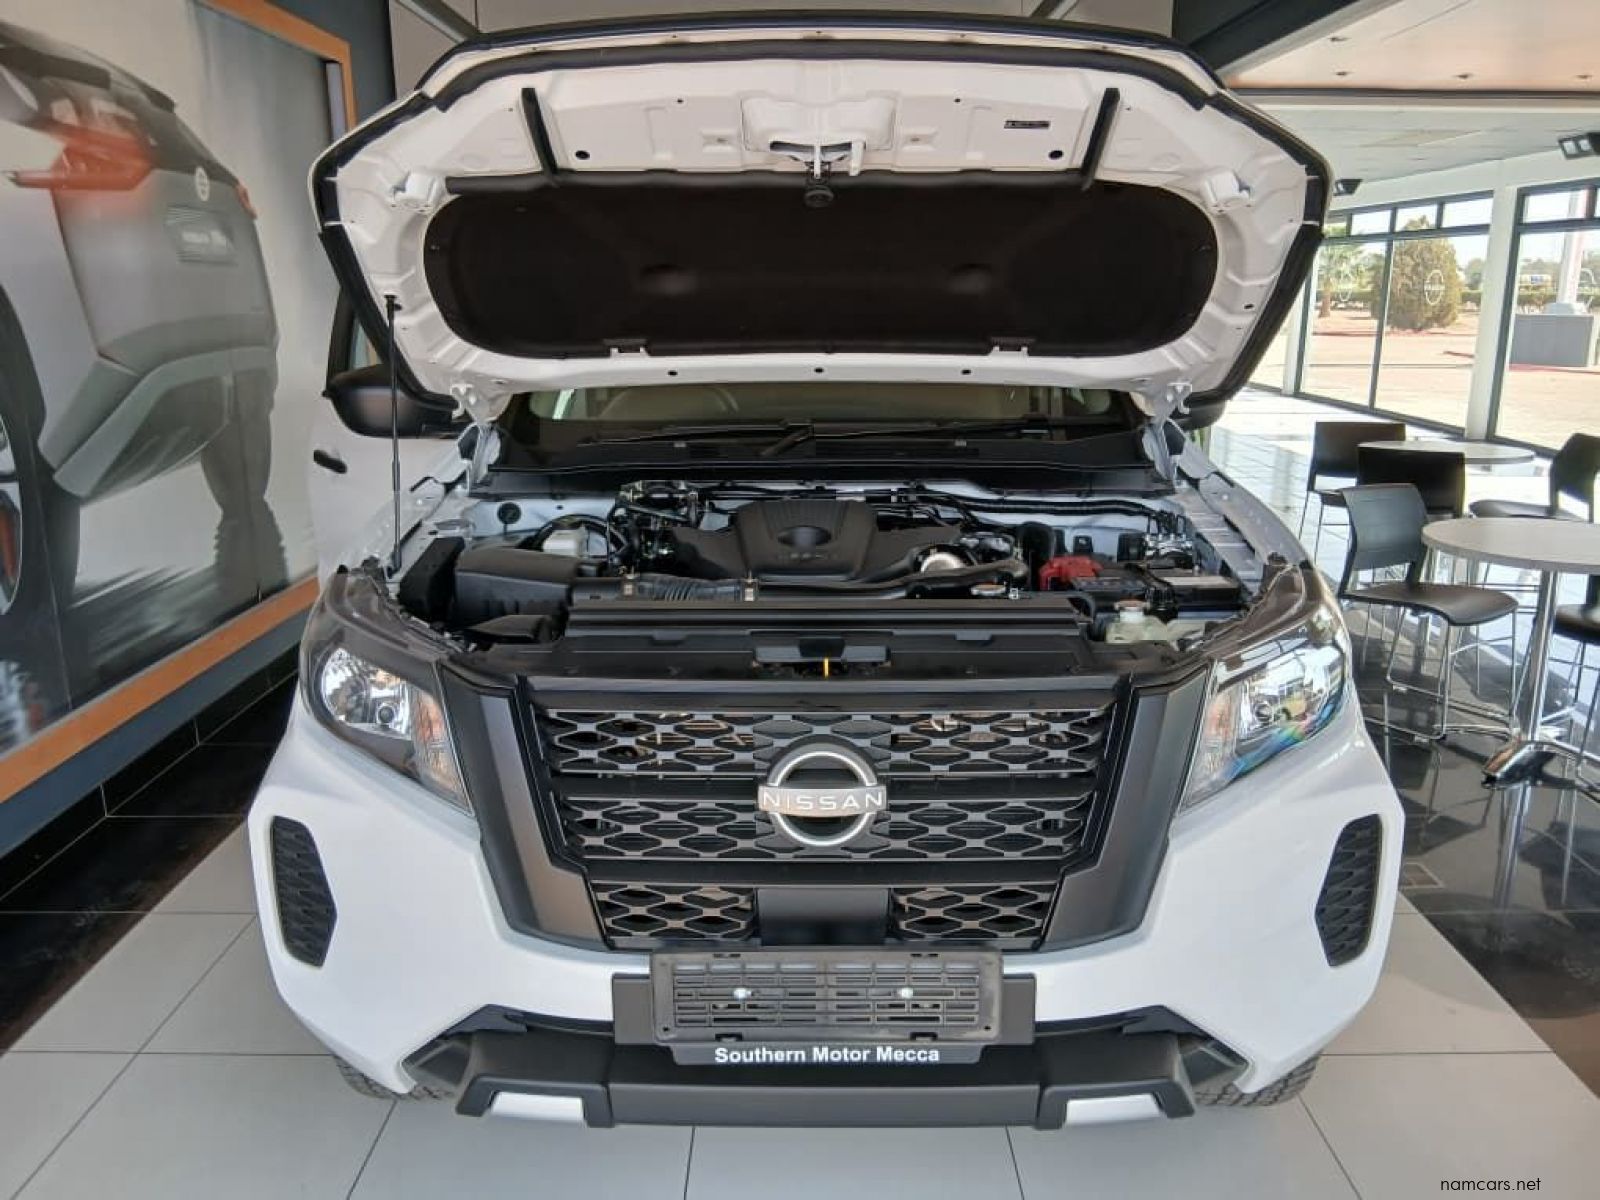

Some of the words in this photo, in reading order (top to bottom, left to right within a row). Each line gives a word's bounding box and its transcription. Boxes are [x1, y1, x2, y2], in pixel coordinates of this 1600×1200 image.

[763, 791, 883, 811] NISSAN
[714, 1047, 806, 1063] Southern
[812, 1046, 871, 1063] Motor
[875, 1046, 941, 1063] Mecca
